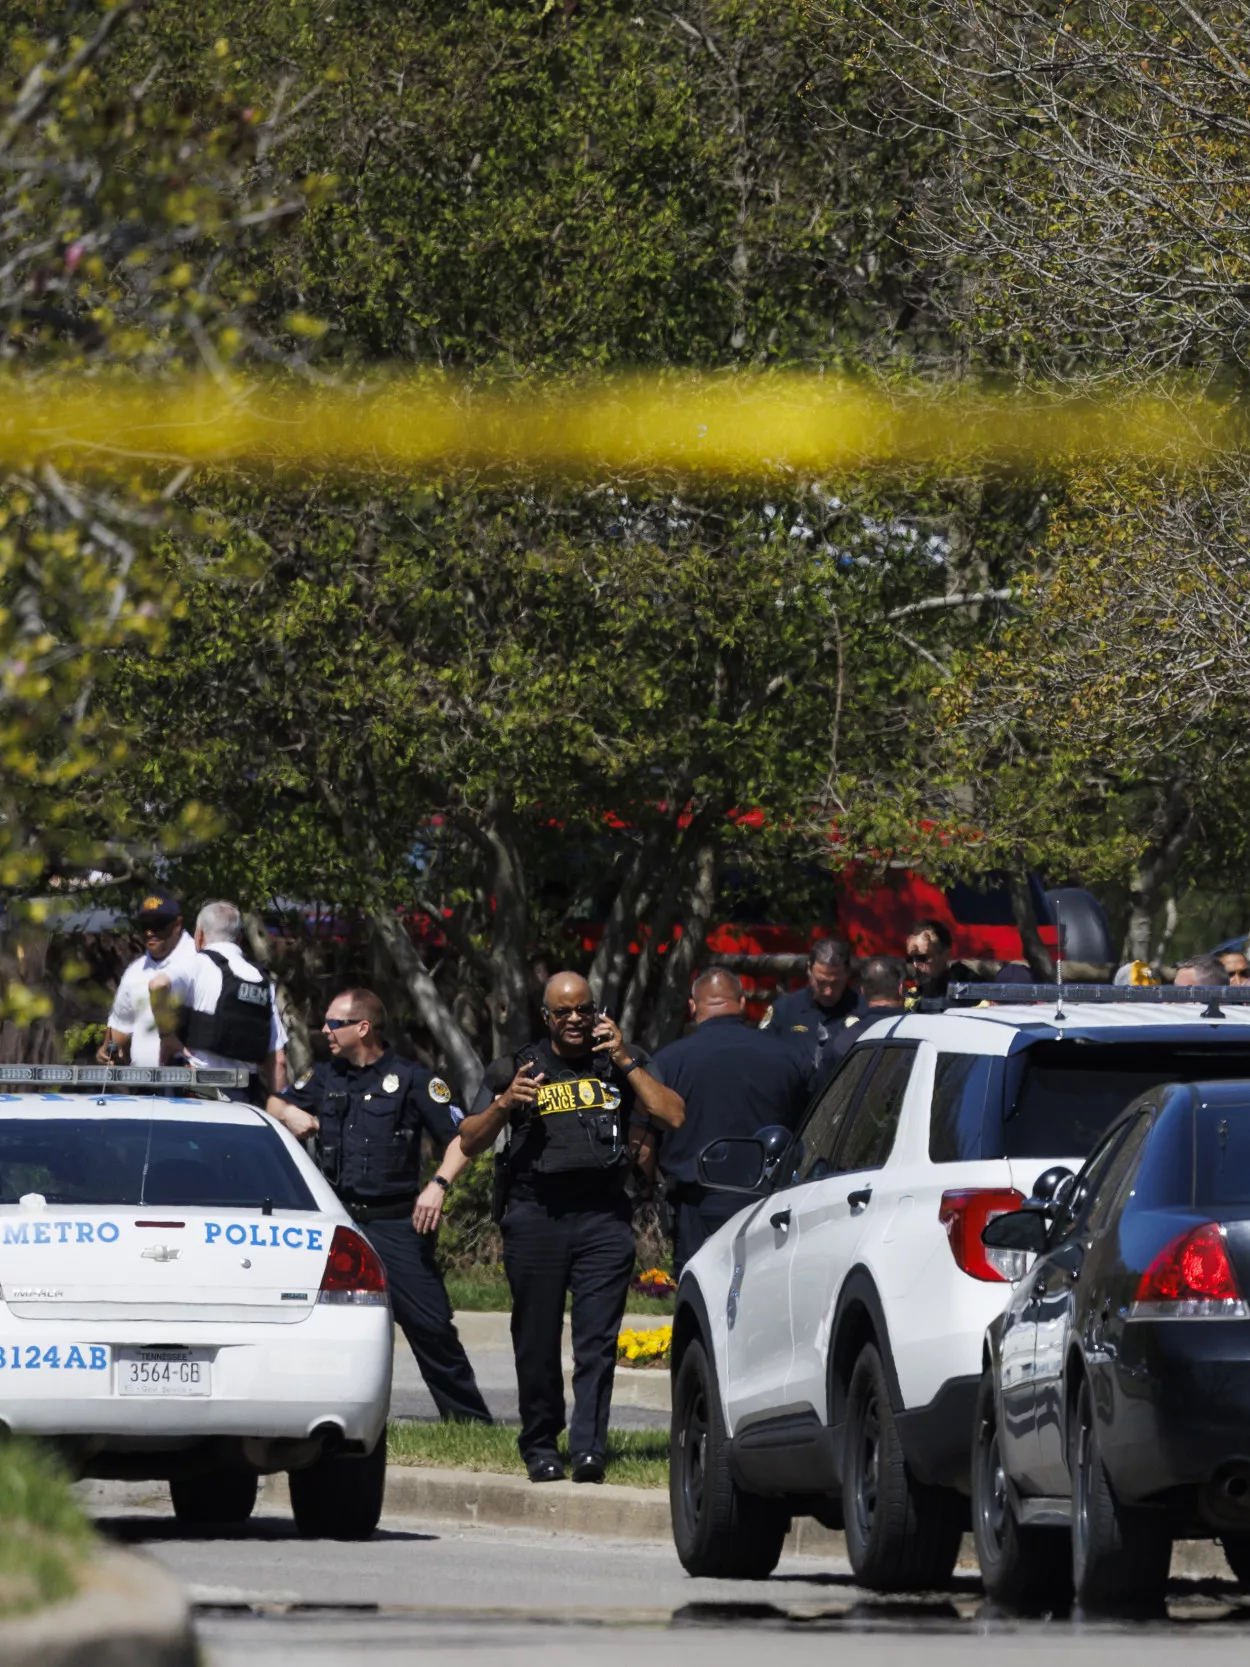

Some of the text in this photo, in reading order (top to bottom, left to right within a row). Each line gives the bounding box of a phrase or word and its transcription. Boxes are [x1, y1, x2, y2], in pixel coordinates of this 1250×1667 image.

[538, 1084, 573, 1101] METRO
[3, 1222, 323, 1250] METRO POLICE
[141, 1352, 188, 1361] TENNESSEE
[130, 1362, 200, 1383] 3564-GB
